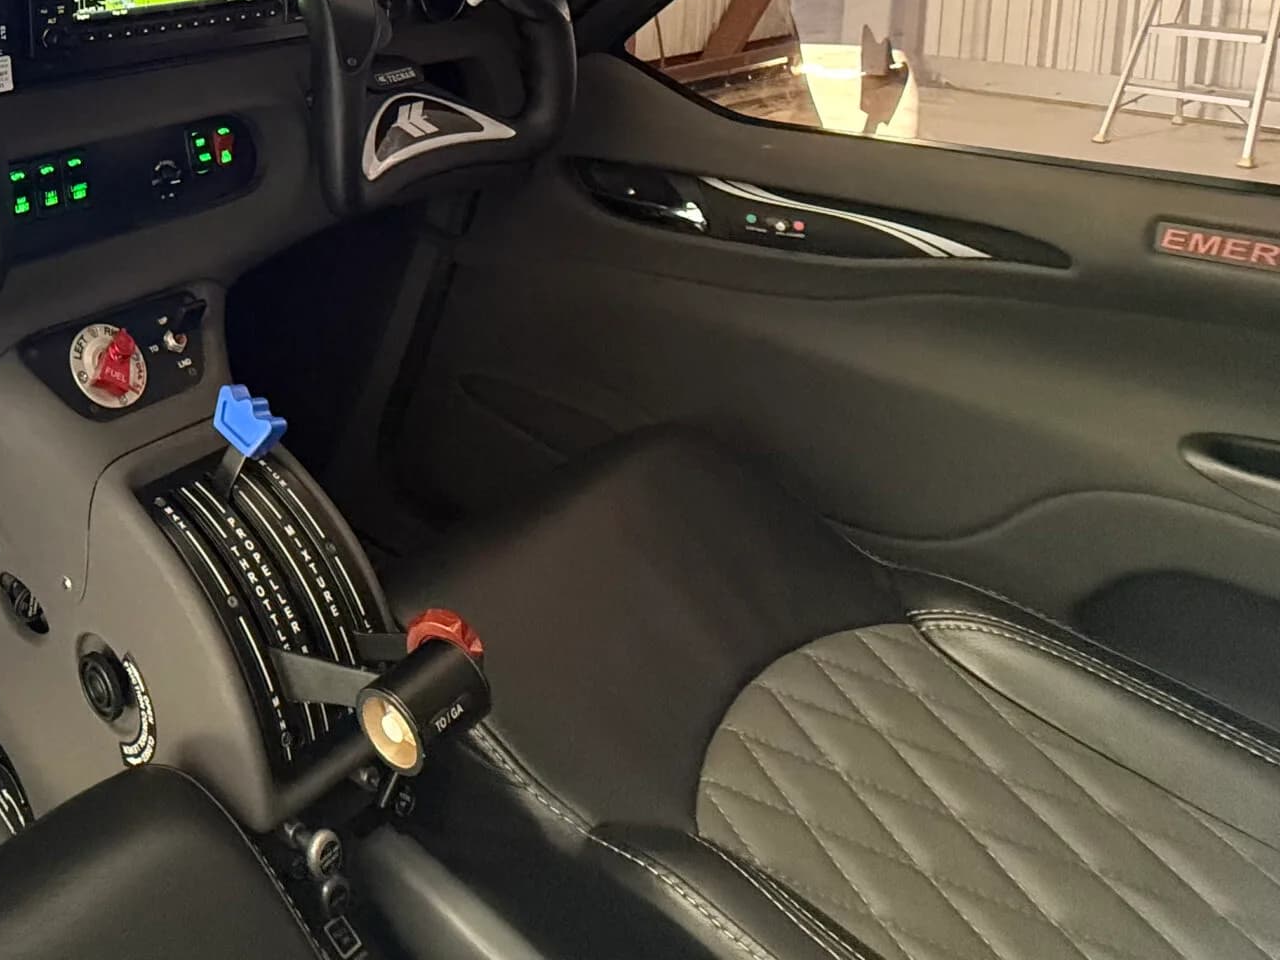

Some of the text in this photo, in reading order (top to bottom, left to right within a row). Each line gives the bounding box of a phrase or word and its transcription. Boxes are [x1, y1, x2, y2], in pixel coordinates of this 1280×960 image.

[1161, 228, 1280, 266] EMER
[73, 334, 87, 361] LEFT
[105, 367, 127, 384] FUEL
[258, 459, 288, 488] RICH
[163, 506, 188, 530] MAX
[226, 516, 301, 634] PROPELLER
[284, 524, 339, 618] MIXTURE
